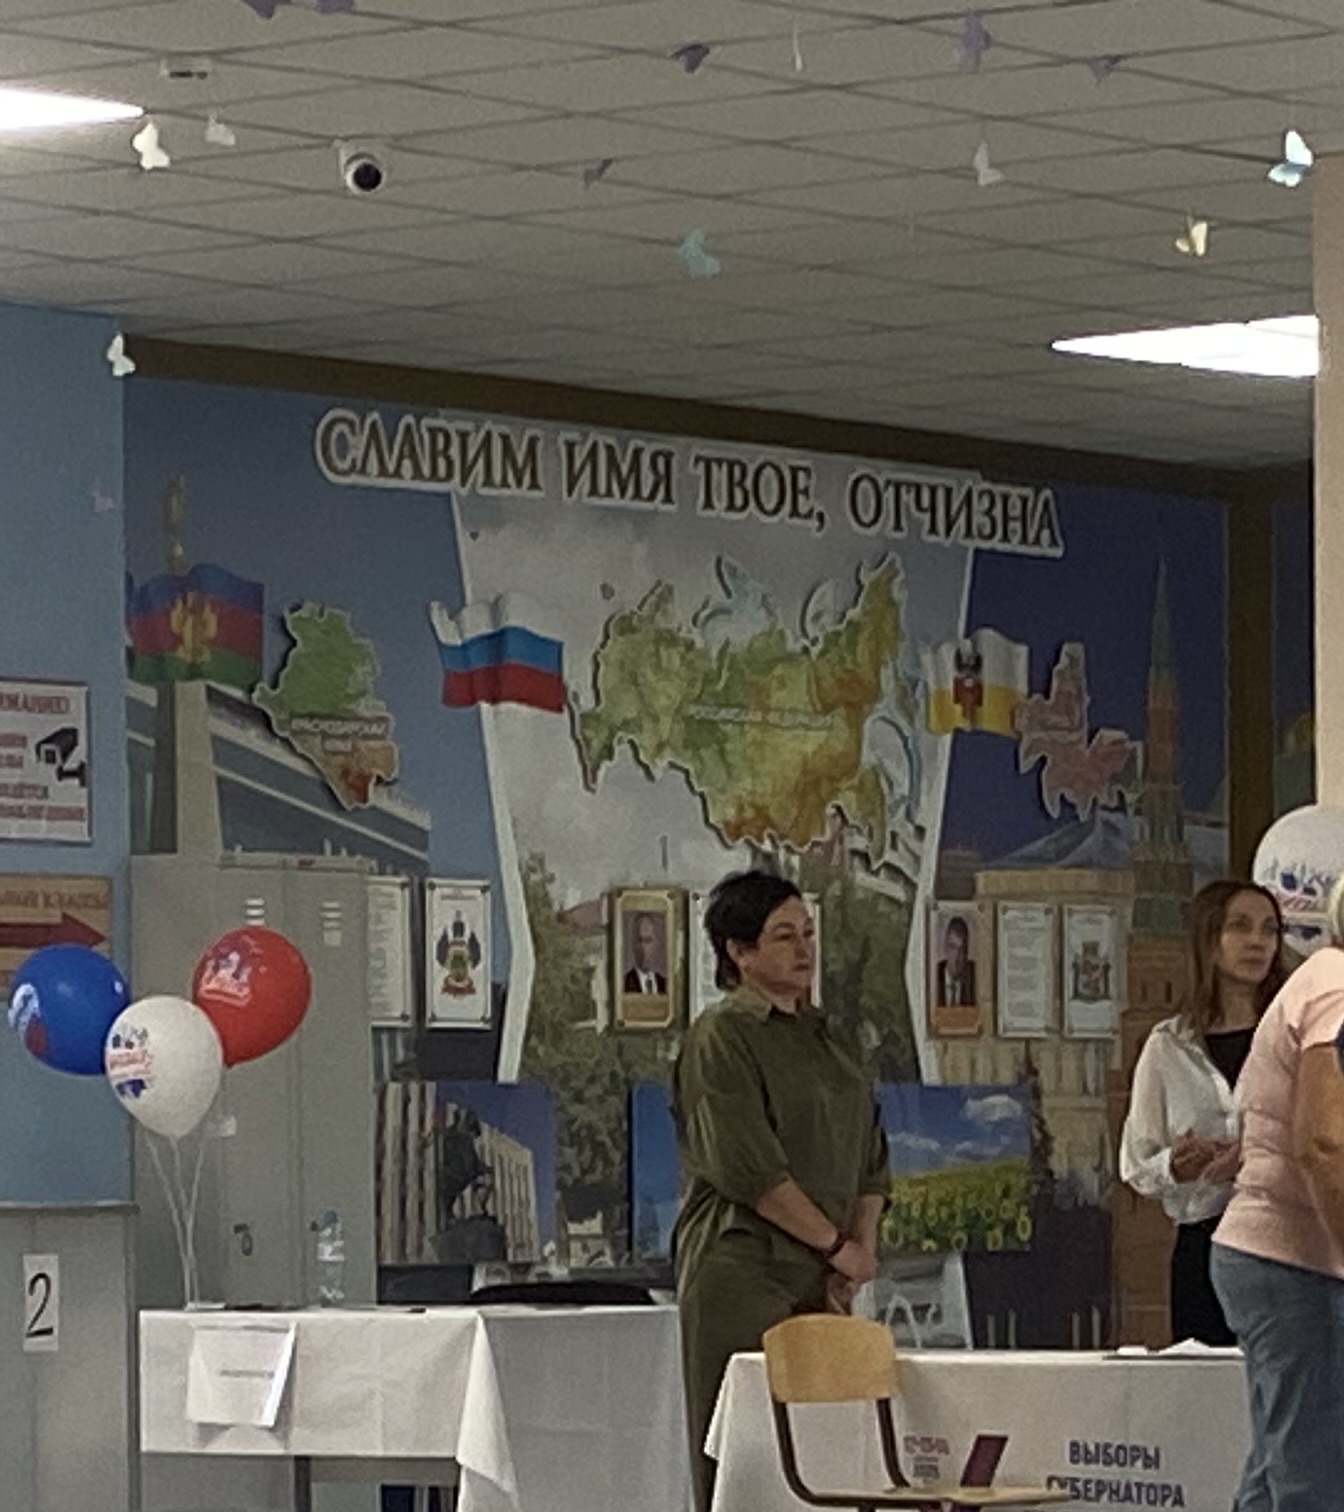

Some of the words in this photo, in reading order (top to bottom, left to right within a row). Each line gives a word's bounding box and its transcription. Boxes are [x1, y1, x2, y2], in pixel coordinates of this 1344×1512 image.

[318, 415, 543, 492] СЛАВИМ
[563, 439, 676, 507] ИМЯ
[692, 452, 826, 533] ТВОЕ,
[848, 474, 1060, 551] ОТЧИЗНА
[24, 1271, 54, 1338] 2
[1068, 1440, 1161, 1470] ВЫБОРЫ
